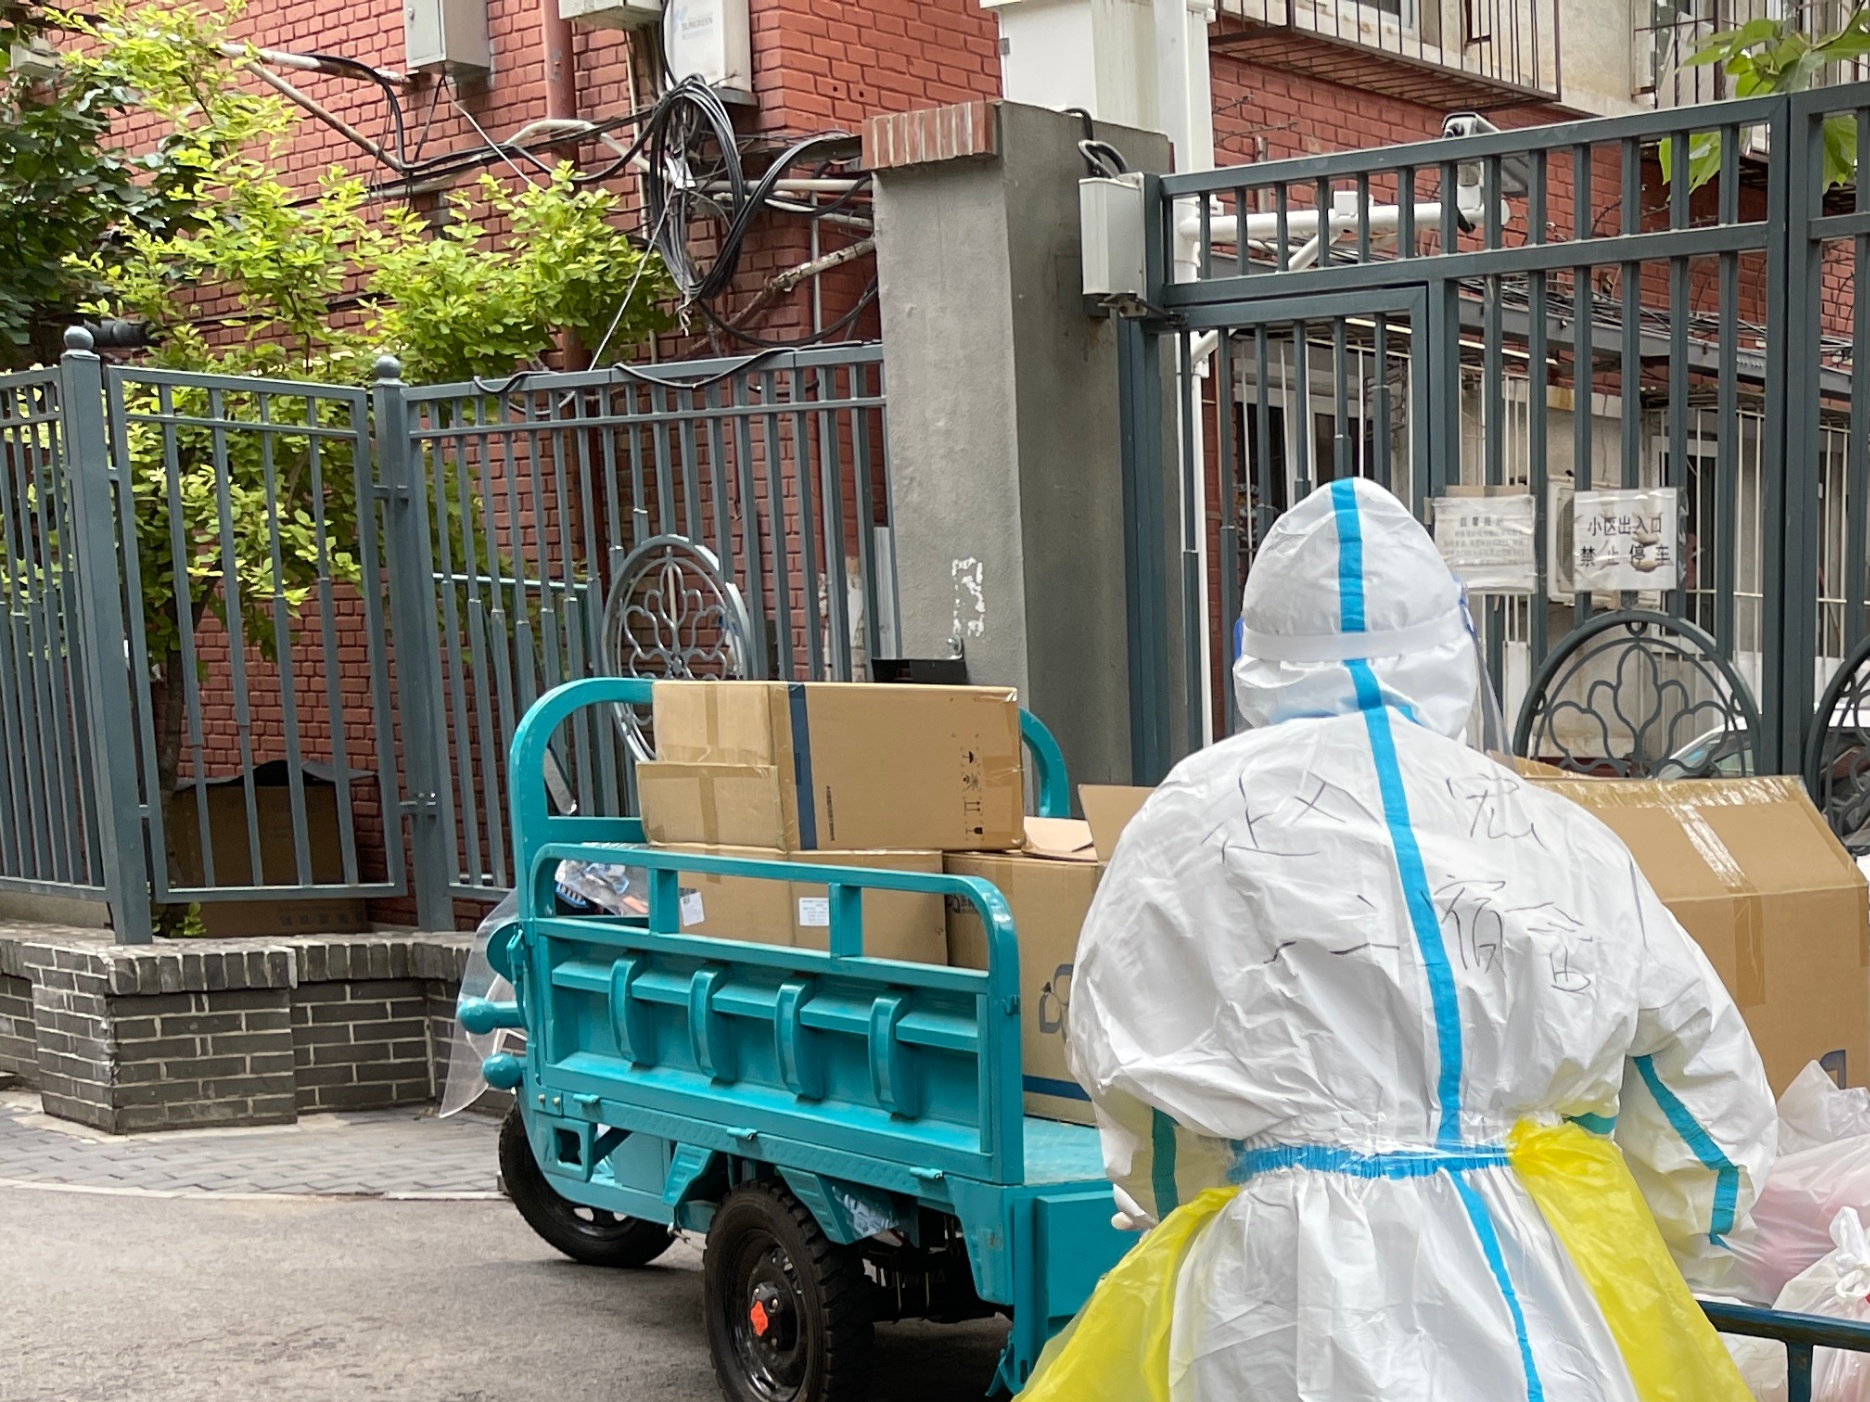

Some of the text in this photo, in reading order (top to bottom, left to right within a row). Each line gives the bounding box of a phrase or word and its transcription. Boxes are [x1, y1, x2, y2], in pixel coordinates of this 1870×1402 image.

[1588, 515, 1662, 537] 小区出入口
[1581, 543, 1671, 567] 禁止停车
